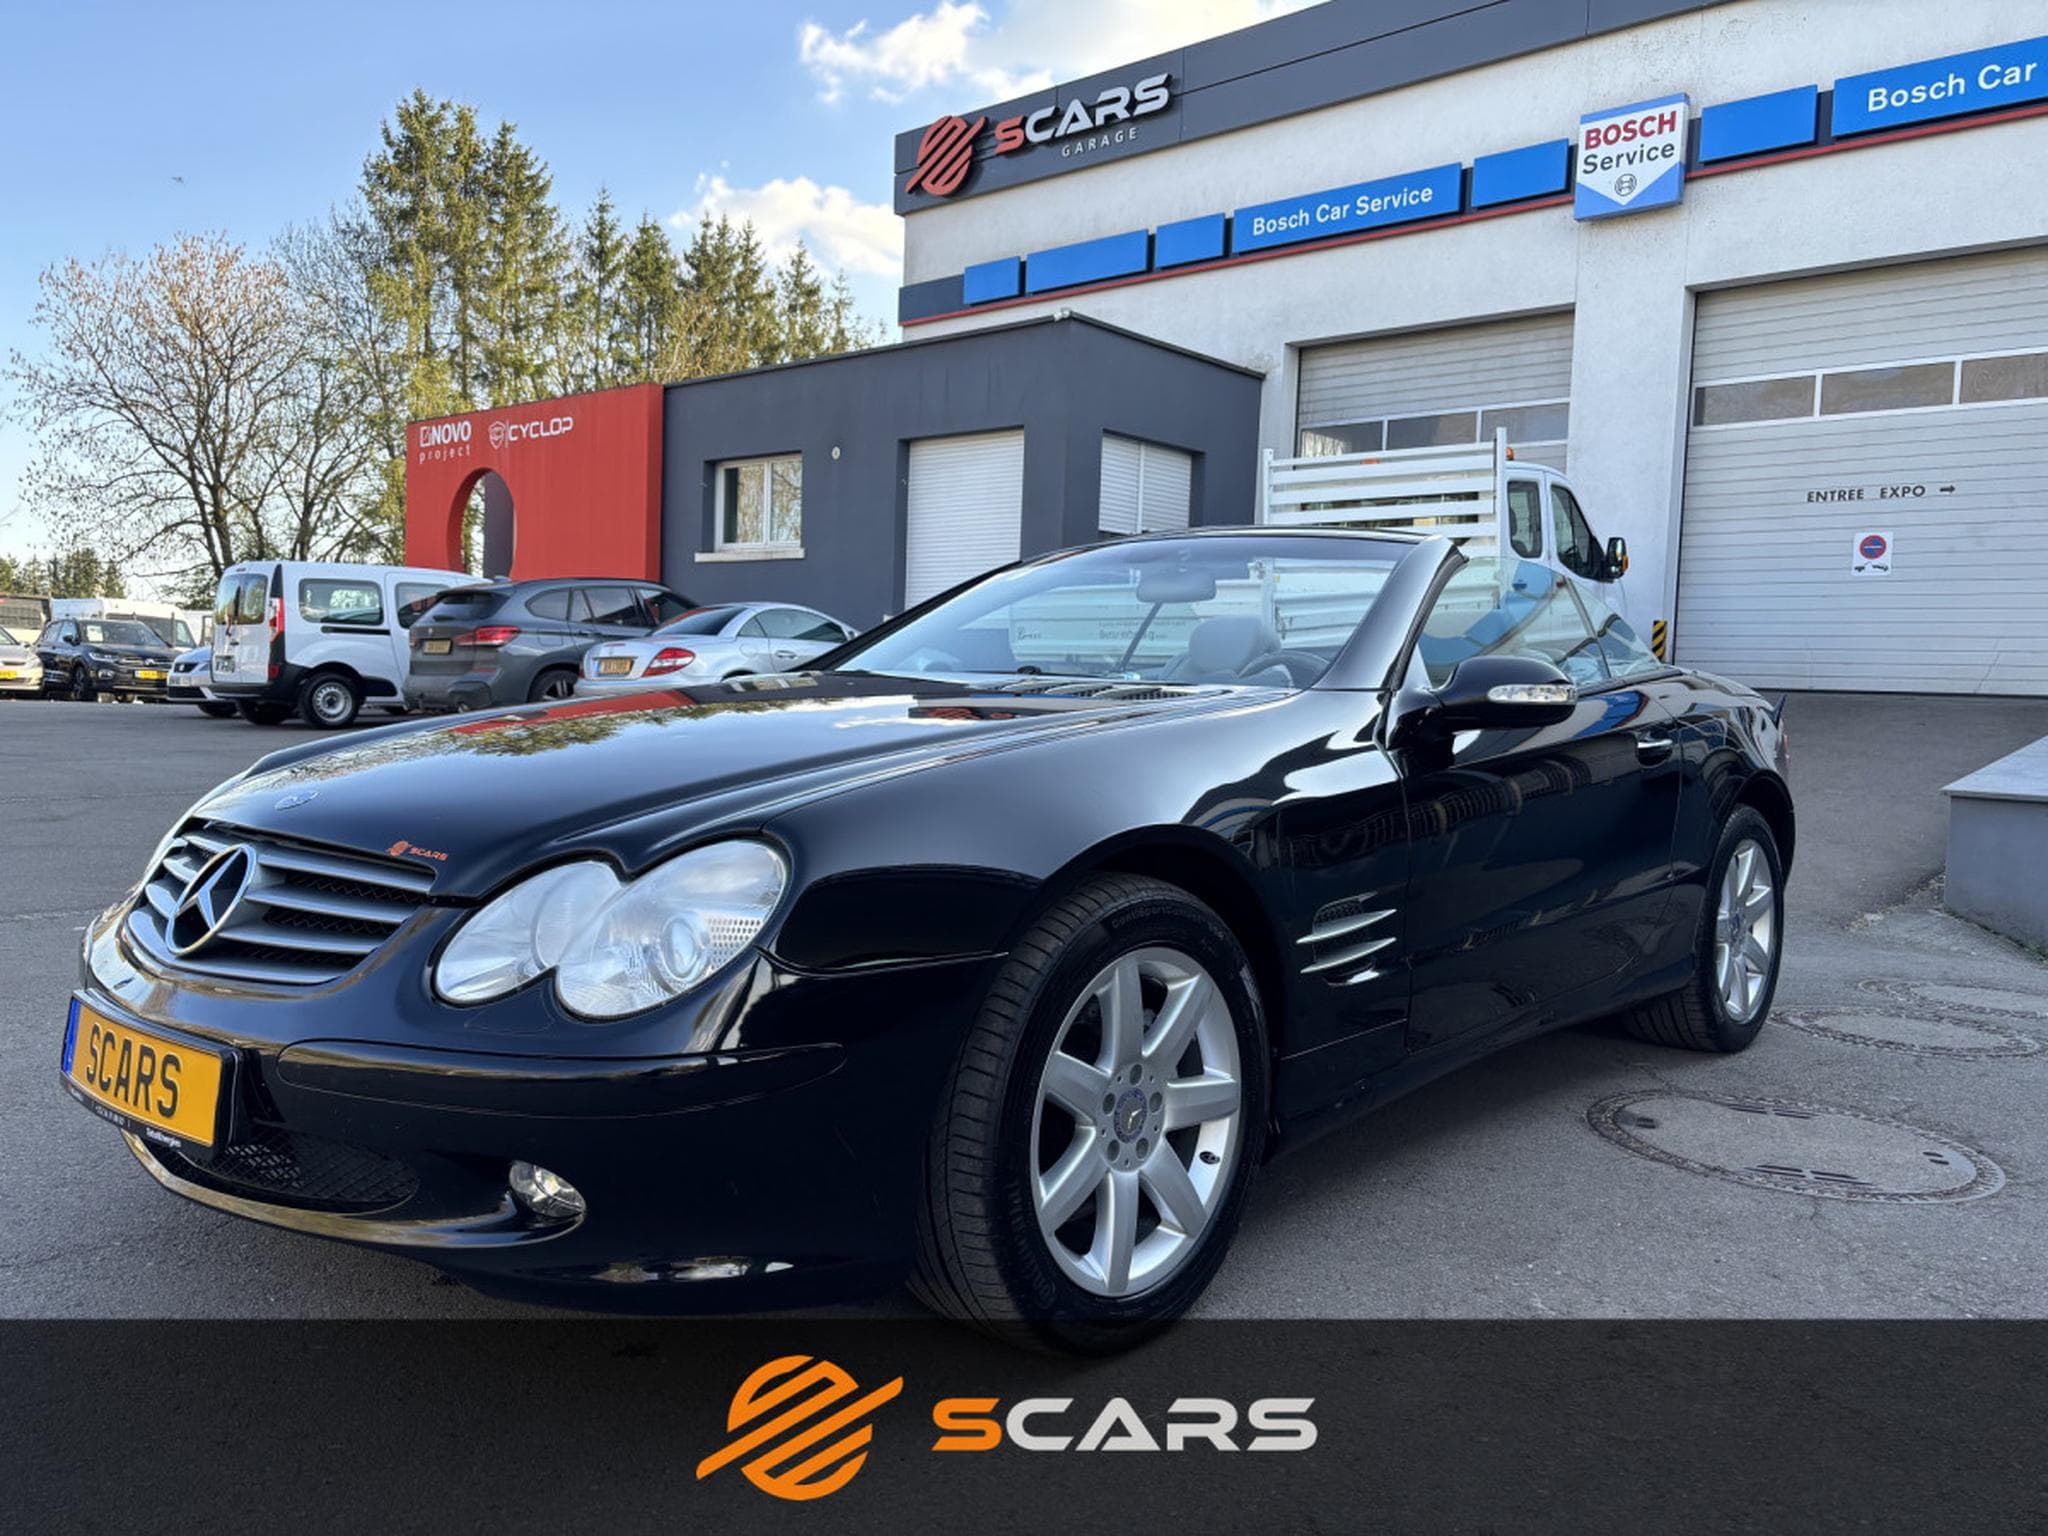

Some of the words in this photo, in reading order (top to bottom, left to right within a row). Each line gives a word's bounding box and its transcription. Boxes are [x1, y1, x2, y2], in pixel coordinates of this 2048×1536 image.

[1868, 73, 1966, 112] Bosch
[1977, 60, 2038, 91] Car
[993, 73, 1172, 154] SCARS
[1583, 110, 1677, 151] BOSCH
[1061, 127, 1138, 158] GARAGE
[1581, 141, 1675, 175] Service
[1252, 208, 1310, 237] Bosch
[1315, 203, 1351, 223] Car
[1355, 185, 1434, 217] Service
[508, 417, 574, 442] CYCLOP
[419, 444, 471, 464] project
[1807, 488, 1865, 503] ENTREE
[1880, 485, 1926, 499] EXPO
[409, 846, 449, 862] SCARS
[86, 1023, 181, 1118] SCARS
